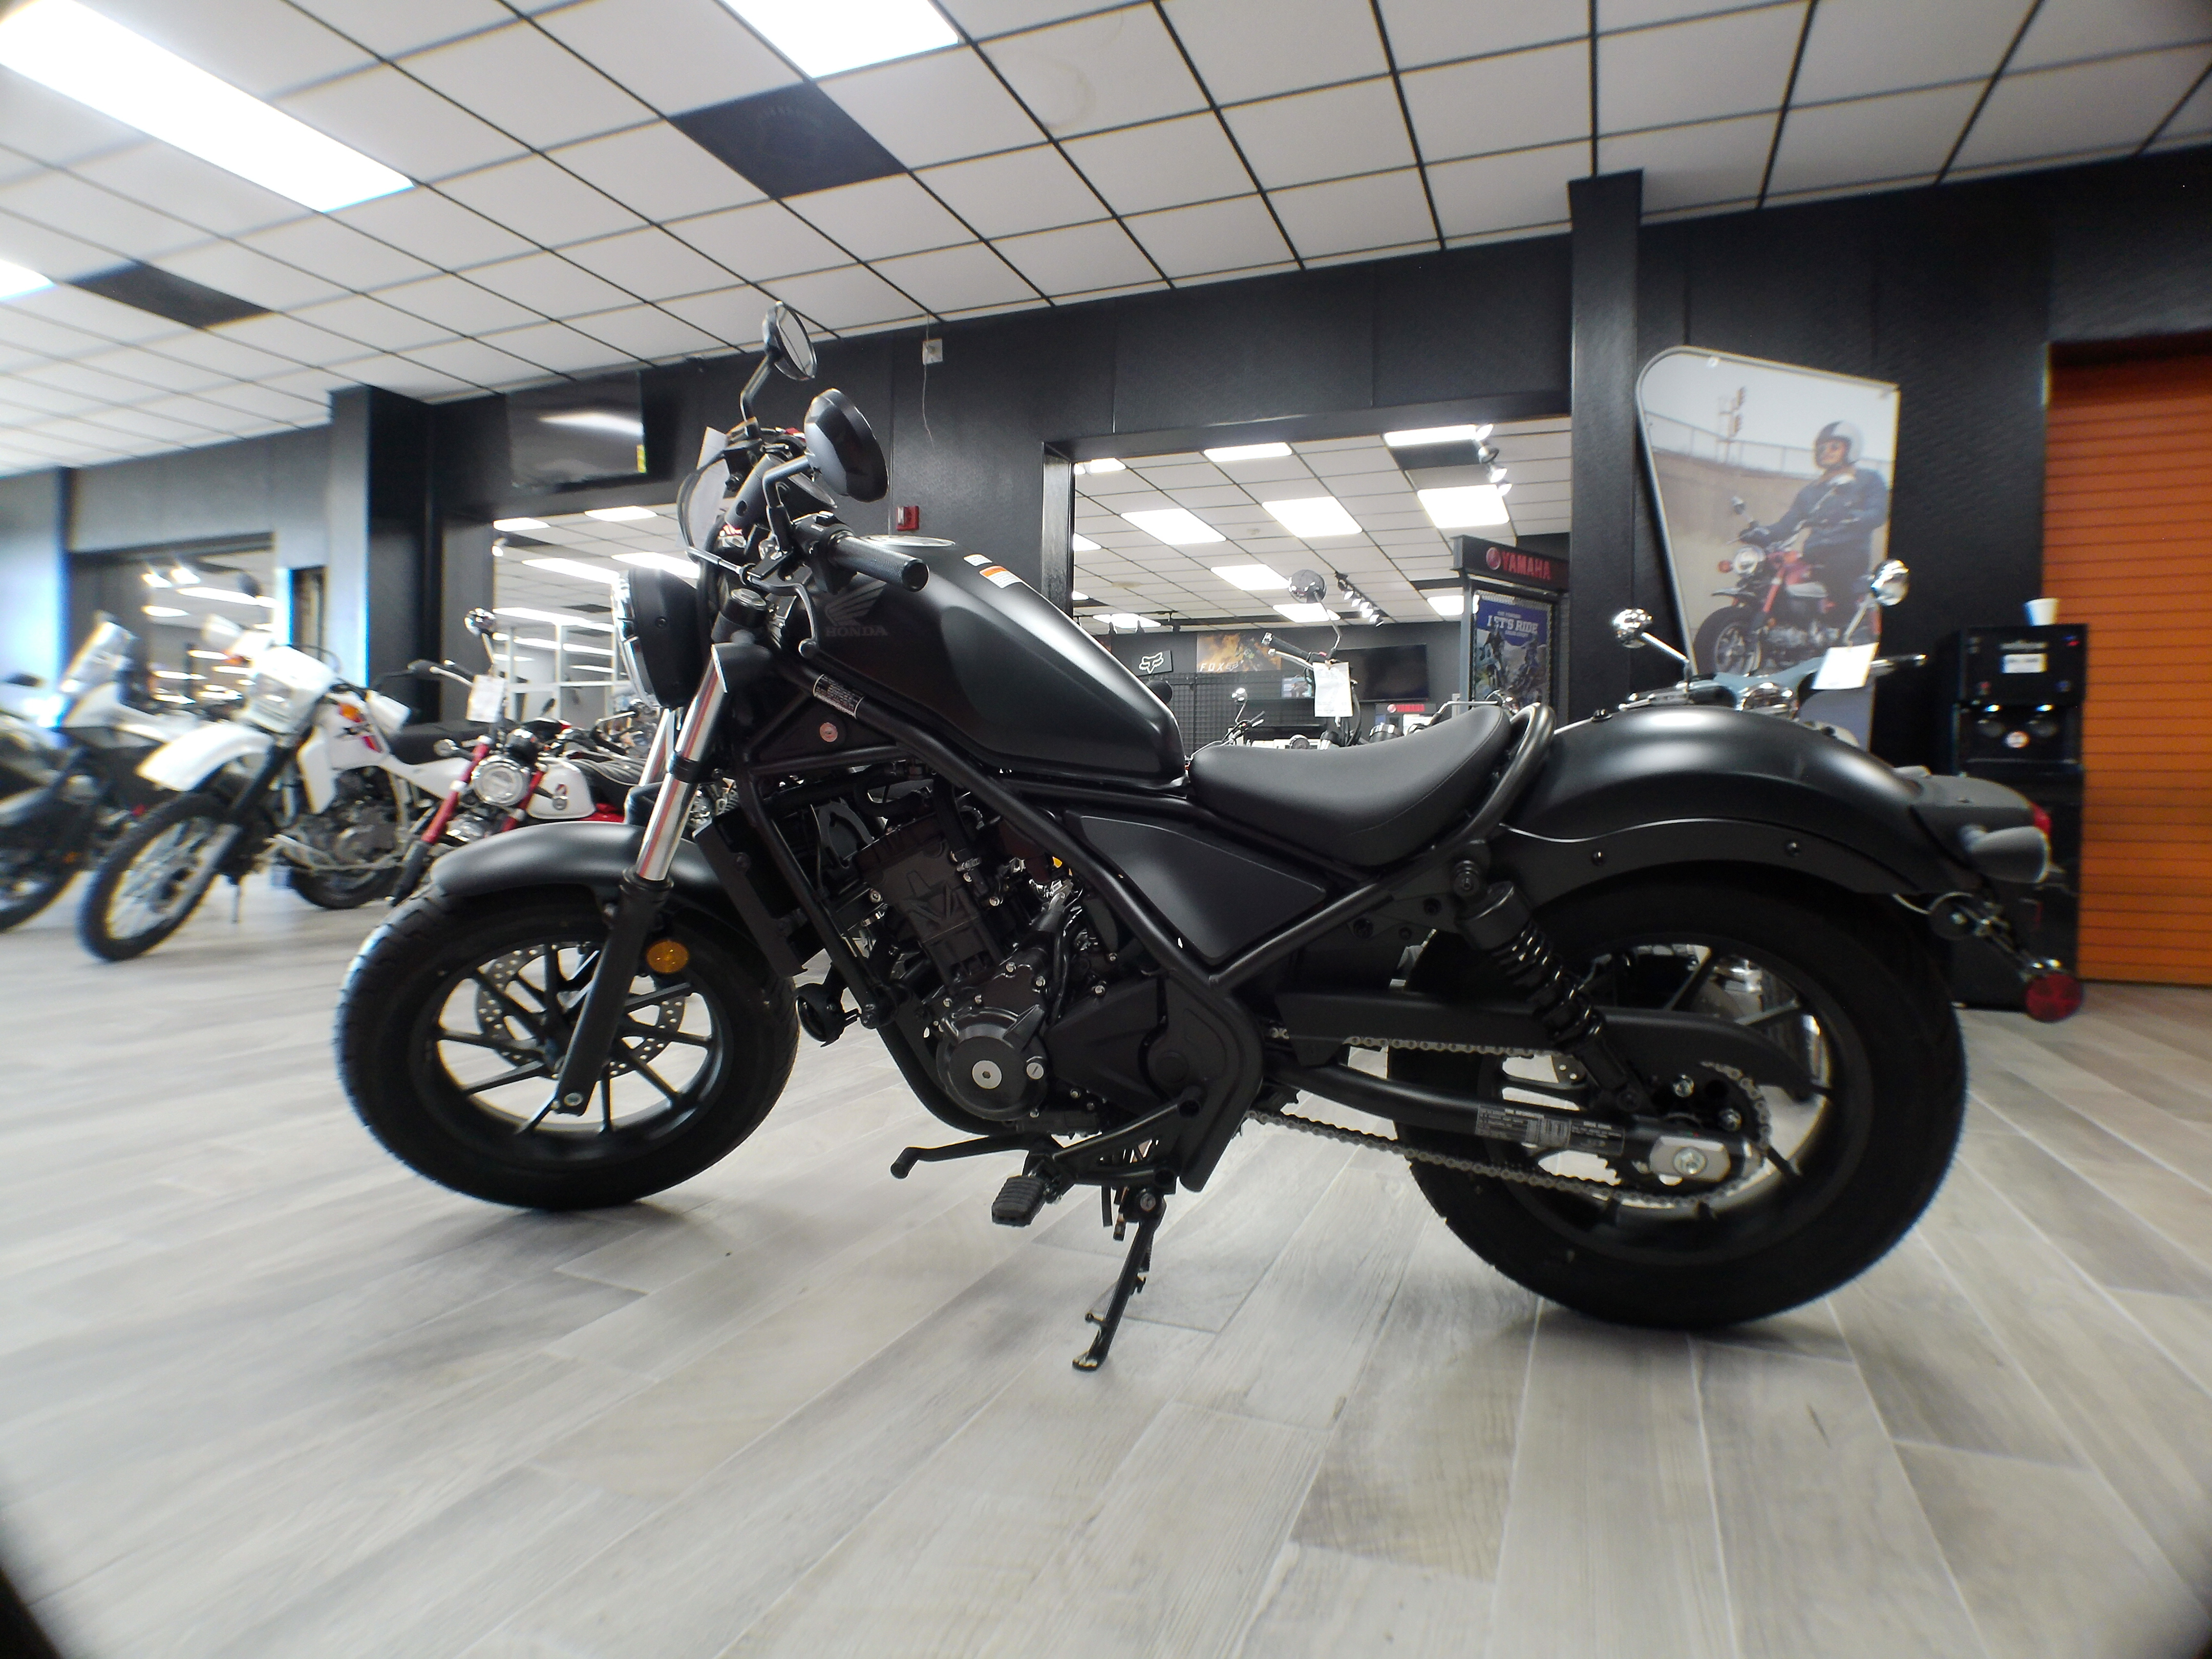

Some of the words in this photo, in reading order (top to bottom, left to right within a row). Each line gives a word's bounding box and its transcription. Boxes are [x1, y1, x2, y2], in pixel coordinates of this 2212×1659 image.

[1502, 551, 1551, 580] YAMAHA
[825, 625, 888, 636] HONDA
[1515, 620, 1539, 634] RIDE
[1199, 663, 1224, 672] FOX
